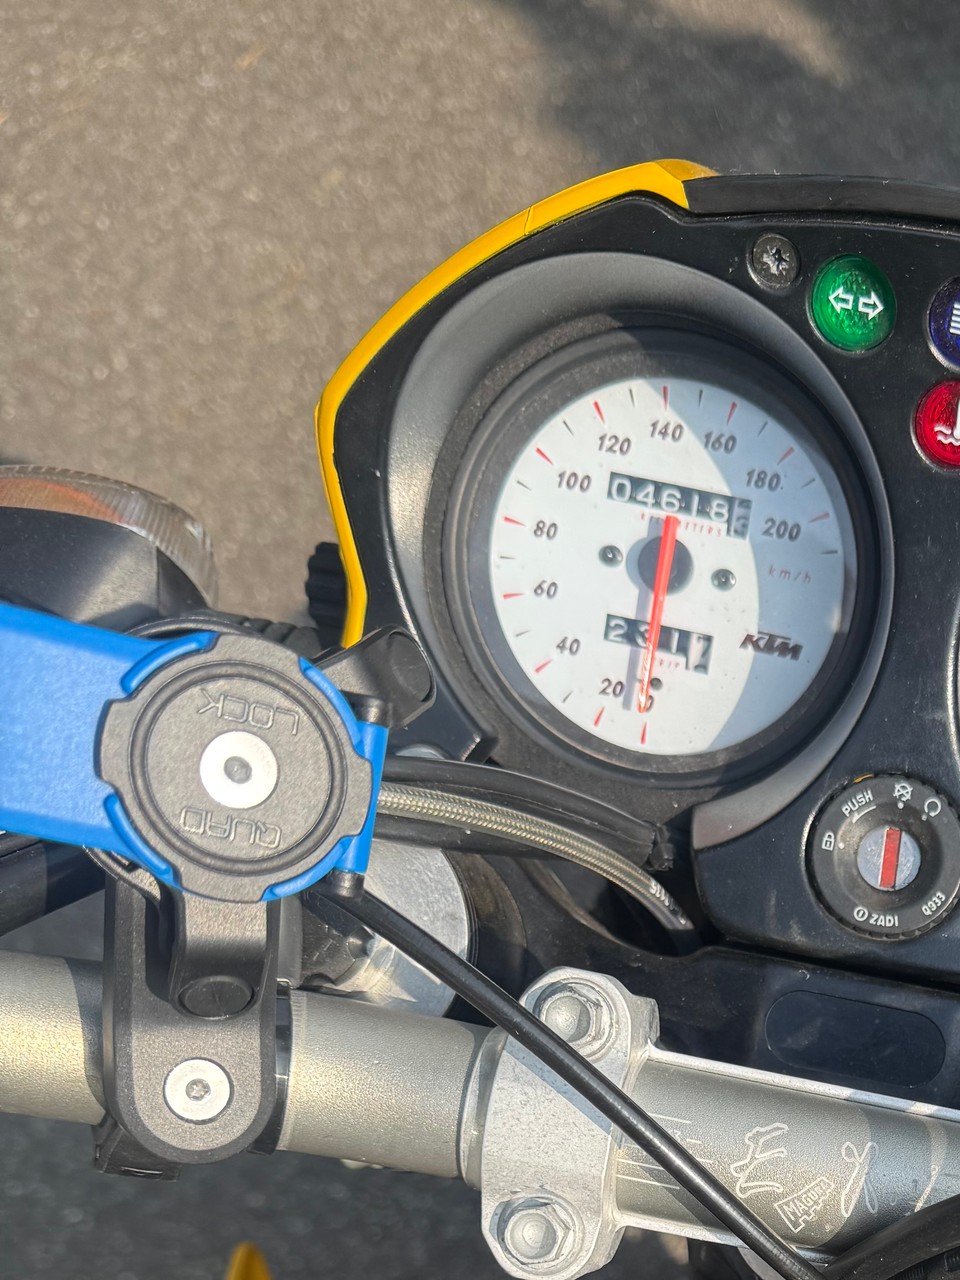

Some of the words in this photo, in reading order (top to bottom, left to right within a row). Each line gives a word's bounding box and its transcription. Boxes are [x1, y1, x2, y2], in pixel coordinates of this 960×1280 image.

[649, 418, 684, 443] 140
[597, 433, 632, 456] 120
[703, 431, 738, 455] 160
[556, 469, 592, 493] 100
[745, 468, 780, 491] 180
[533, 519, 558, 541] 80
[761, 517, 801, 542] 200
[768, 563, 812, 585] km/h
[533, 579, 558, 599] 60
[556, 637, 581, 656] 40
[739, 630, 804, 662] KTM
[598, 677, 625, 698] 20
[197, 688, 300, 737] LOCK
[841, 789, 875, 818] PUSH
[179, 806, 283, 849] QUAD
[921, 890, 947, 917] Q933
[869, 912, 899, 927] ZADI
[782, 1181, 830, 1222] MAGURA
